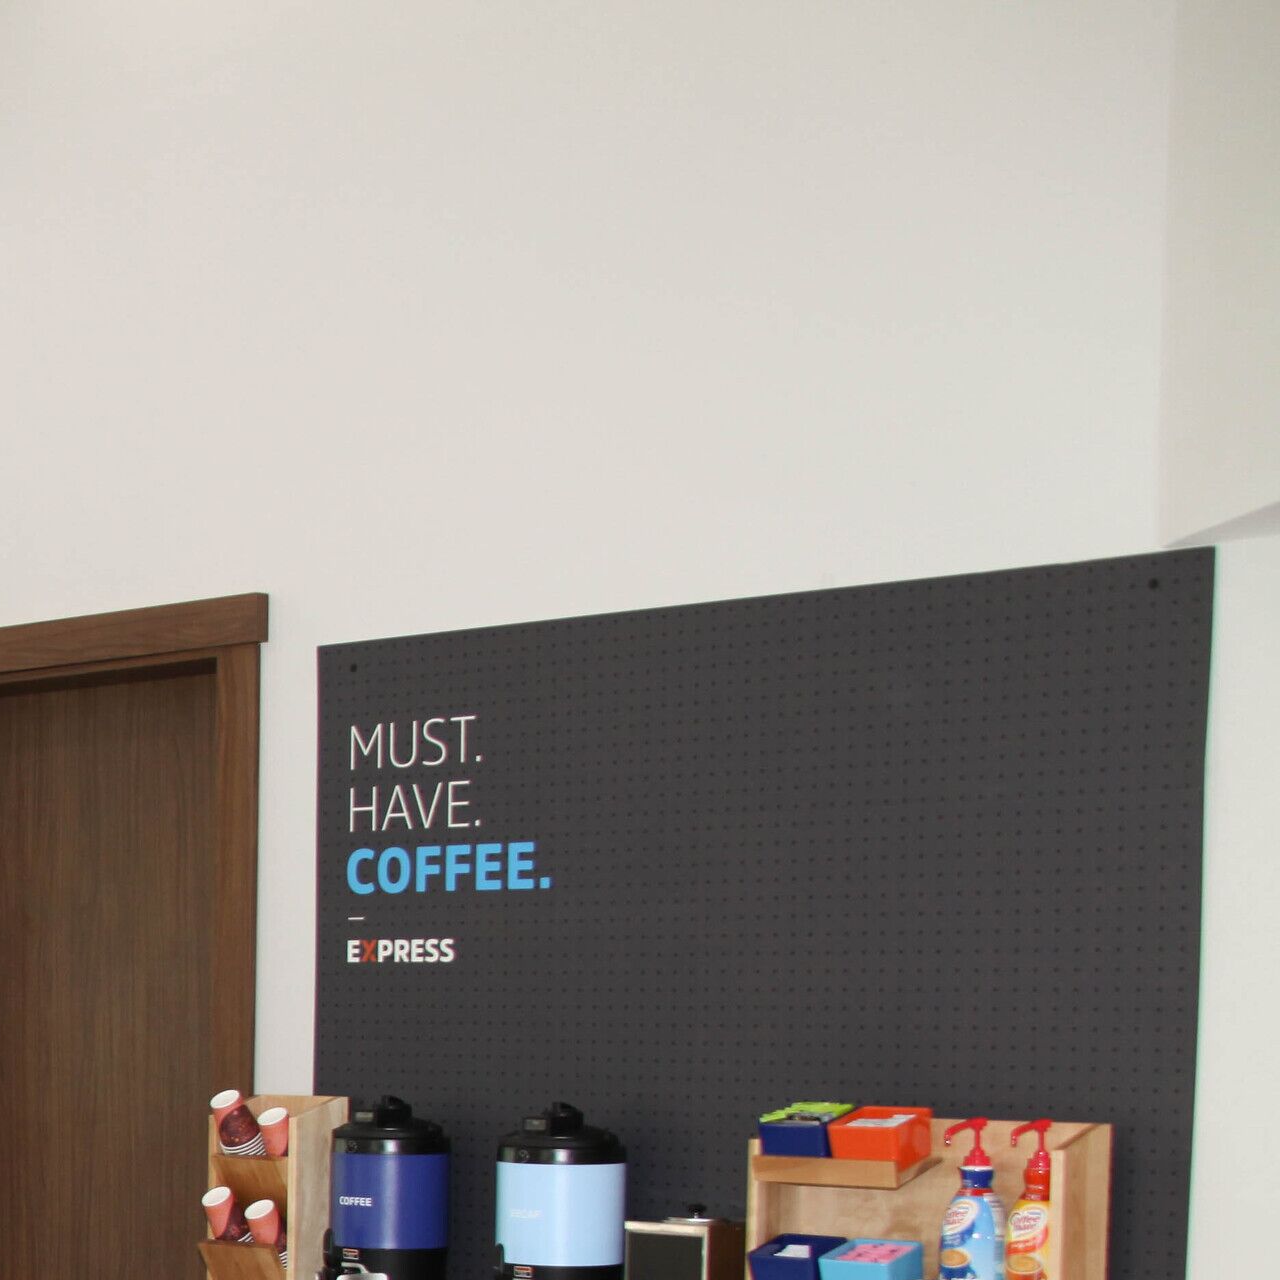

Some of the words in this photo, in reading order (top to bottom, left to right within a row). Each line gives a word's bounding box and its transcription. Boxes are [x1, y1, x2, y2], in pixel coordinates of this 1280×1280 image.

[350, 715, 482, 770] MUST.
[349, 780, 481, 832] HAVE.
[346, 841, 552, 895] COFFEE.
[346, 938, 455, 963] EXPRESS
[339, 1196, 372, 1206] COFFEE
